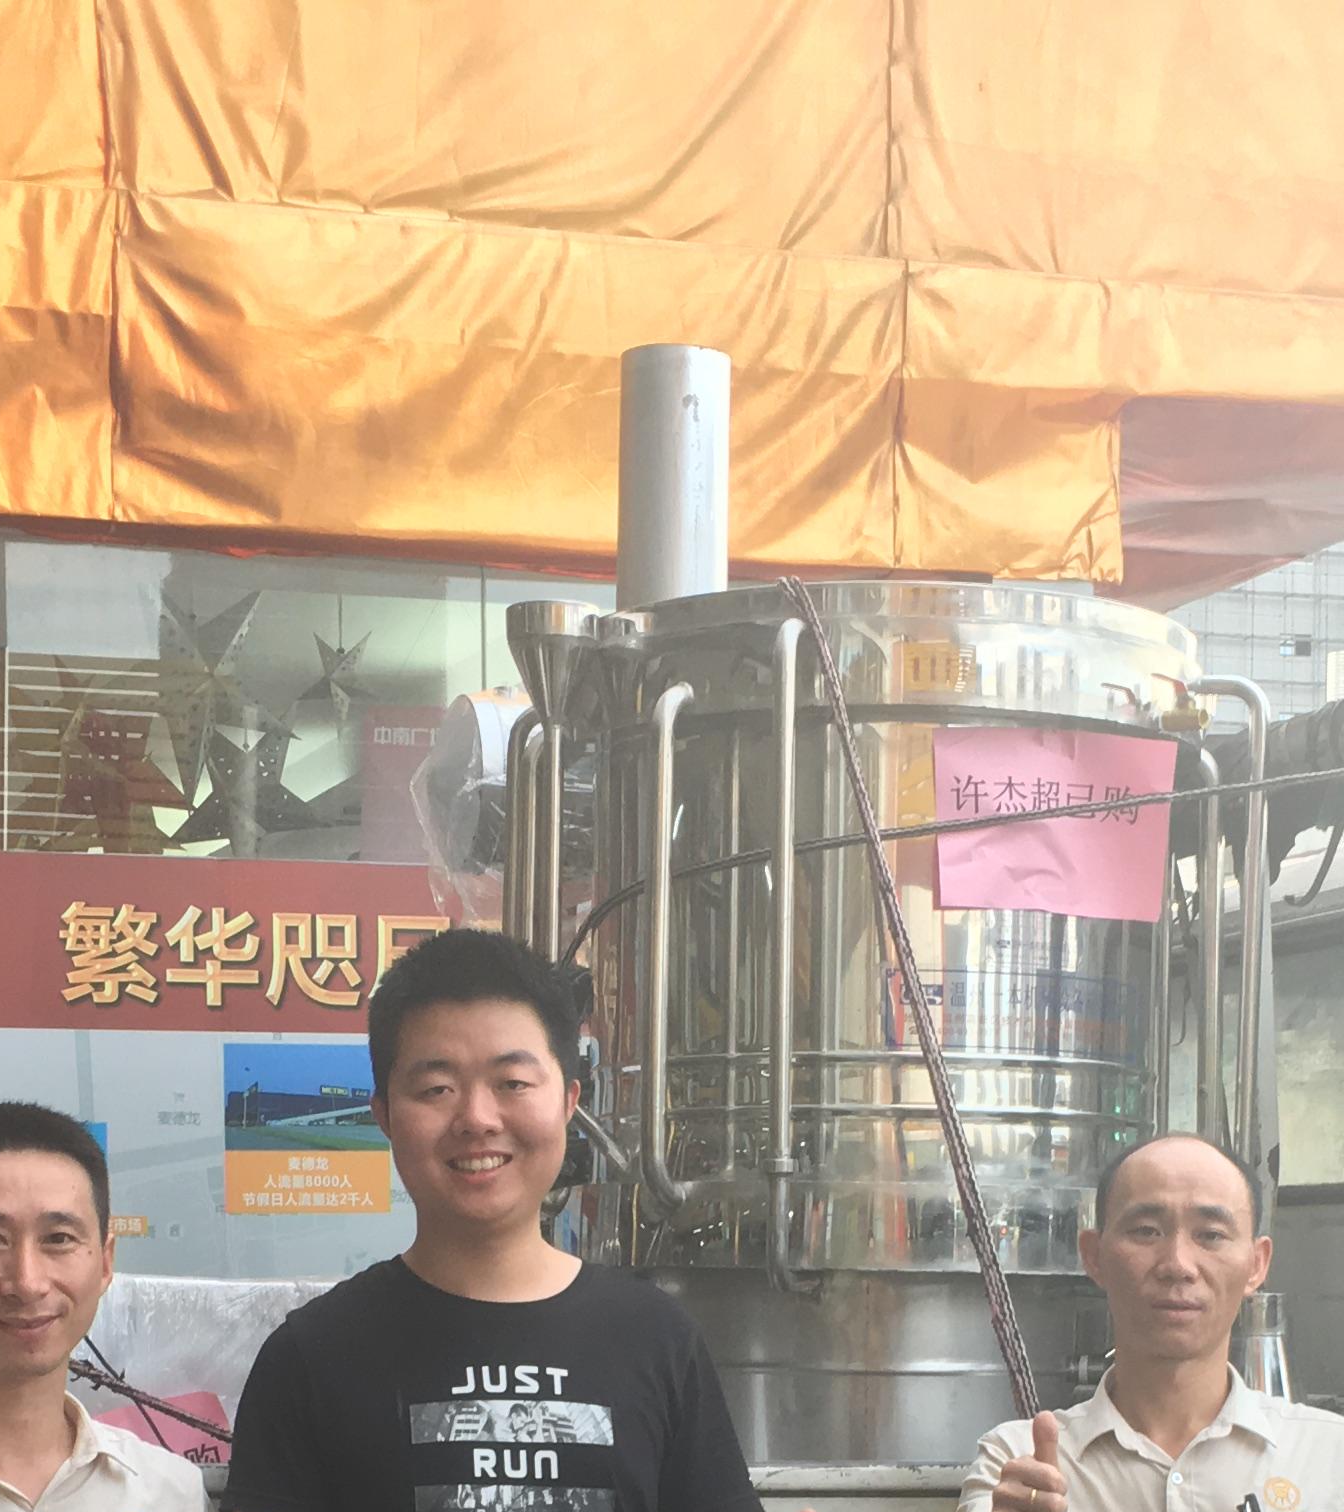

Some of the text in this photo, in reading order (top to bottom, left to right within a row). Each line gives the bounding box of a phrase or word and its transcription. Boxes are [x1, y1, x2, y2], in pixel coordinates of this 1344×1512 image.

[950, 774, 1140, 826] 许杰超已购
[287, 1156, 330, 1171] 麦德龙
[264, 1175, 353, 1190] 人流量8000人
[242, 1193, 374, 1208] 节假日人流量达2千人
[110, 1217, 143, 1233] 市场
[451, 1364, 569, 1396] JUST
[473, 1448, 559, 1480] RUN
